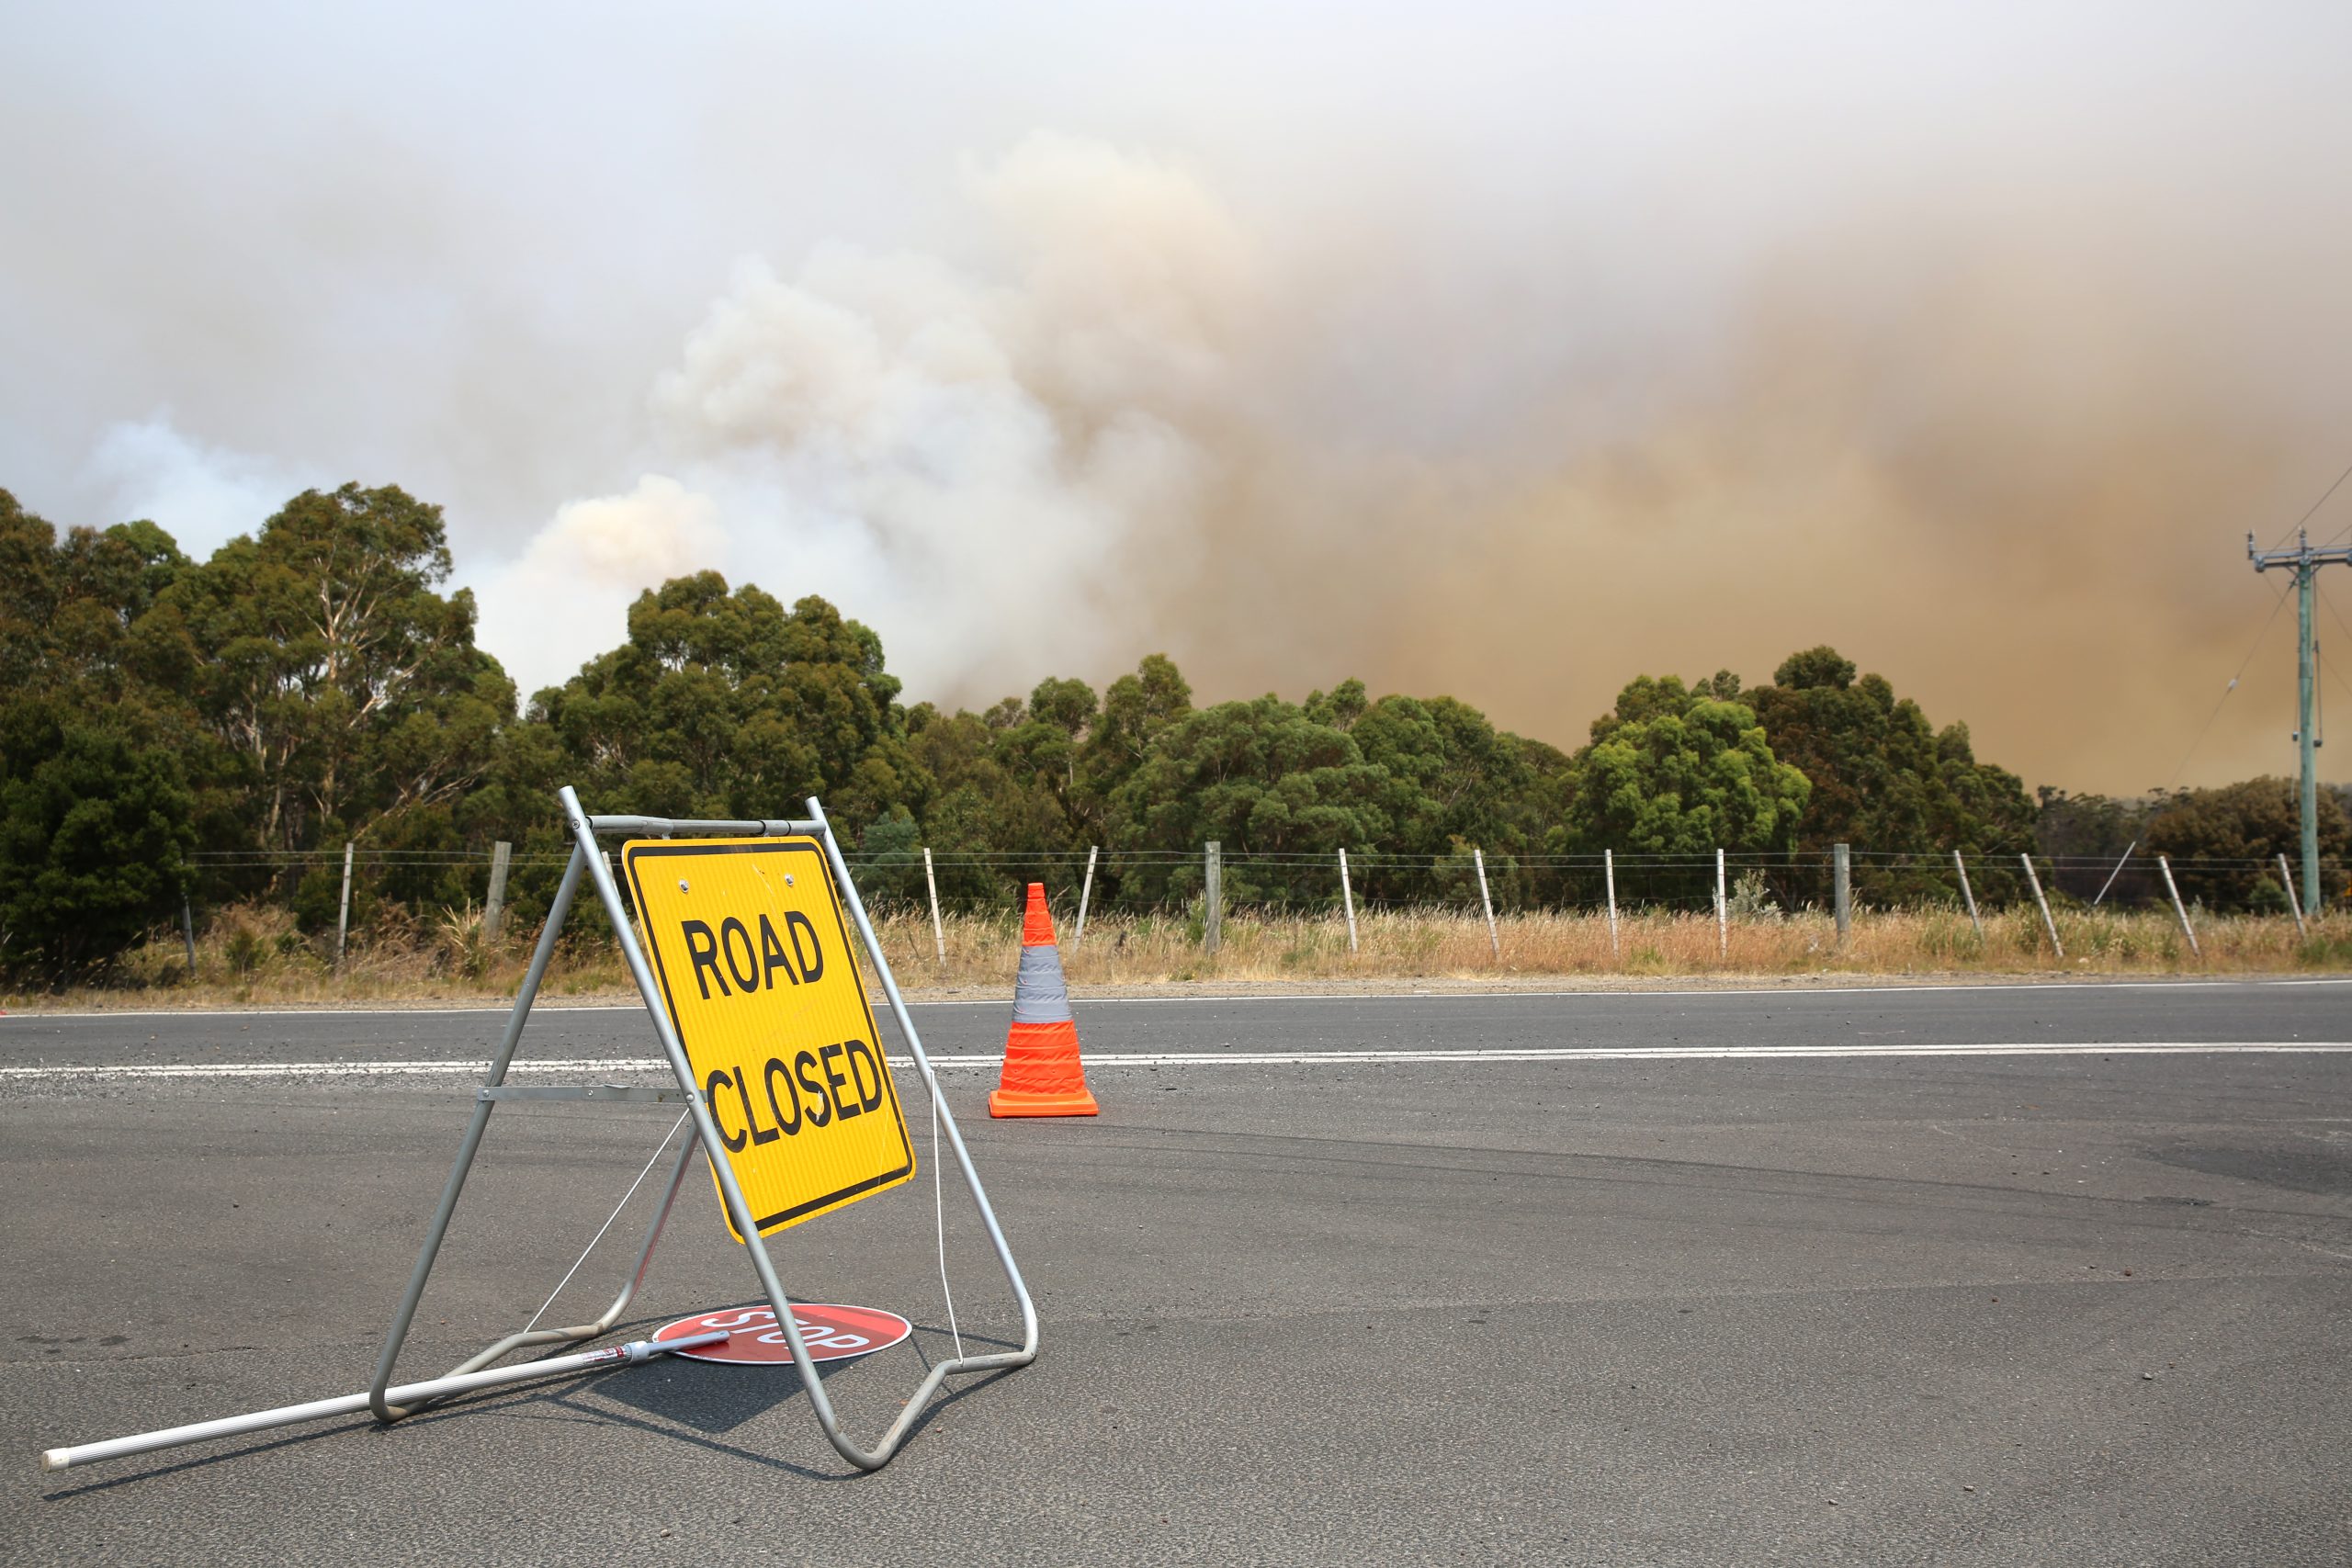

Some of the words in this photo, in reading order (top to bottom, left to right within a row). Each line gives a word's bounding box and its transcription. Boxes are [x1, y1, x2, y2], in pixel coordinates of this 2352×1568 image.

[682, 910, 824, 999] ROAD
[706, 1039, 883, 1154] CLOSED
[700, 1311, 870, 1350] STOP
